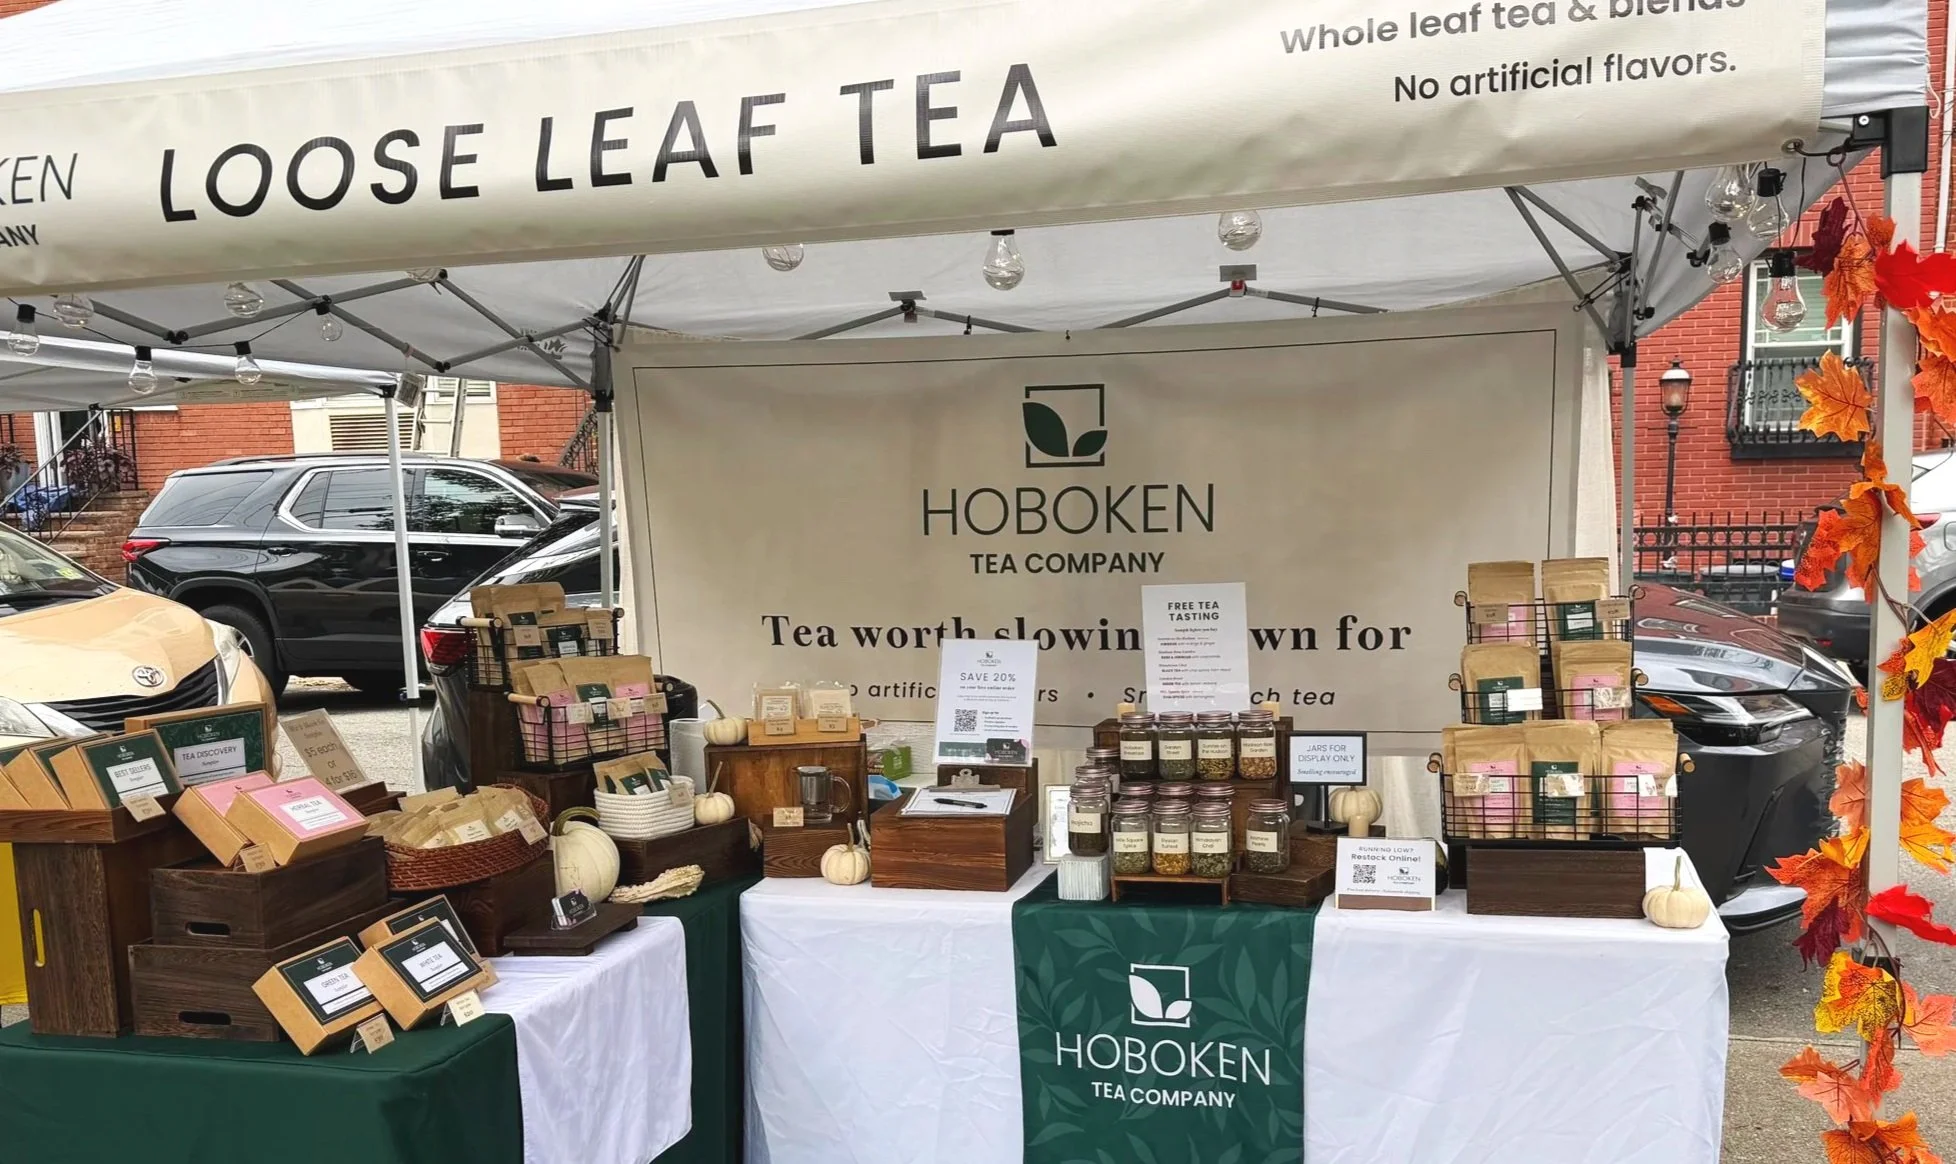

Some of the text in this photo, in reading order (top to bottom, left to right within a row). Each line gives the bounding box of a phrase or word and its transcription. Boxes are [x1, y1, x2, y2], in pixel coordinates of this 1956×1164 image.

[1280, 18, 1399, 53] Whole
[1410, 2, 1482, 38] leaf
[1492, 2, 1556, 29] tea
[1568, 0, 1597, 22] &
[1395, 51, 1736, 102] No artificial flavors.
[160, 63, 1057, 222] LOOSE LEAF TEA
[923, 484, 1214, 536] HOBOKEN
[969, 552, 1165, 574] TEA COMPANY
[1168, 601, 1220, 610] FREE TEA
[1169, 612, 1220, 621] TASTING
[761, 615, 1412, 650] Tea worth slowin wn for
[960, 672, 1017, 682] SAVE 20%
[868, 682, 937, 699] artific
[1293, 689, 1336, 705] tea
[182, 746, 238, 761] TEA DISCOVERY
[317, 742, 338, 755] each
[1307, 744, 1346, 752] JARS FOR
[327, 760, 337, 768] or
[1298, 755, 1355, 763] DISPLAY ONLY
[114, 764, 152, 778] BEST SELLERS
[1351, 854, 1421, 863] Restock Online!
[1055, 1032, 1271, 1085] HOBOKEN
[1091, 1081, 1236, 1108] TEA COMPANY
